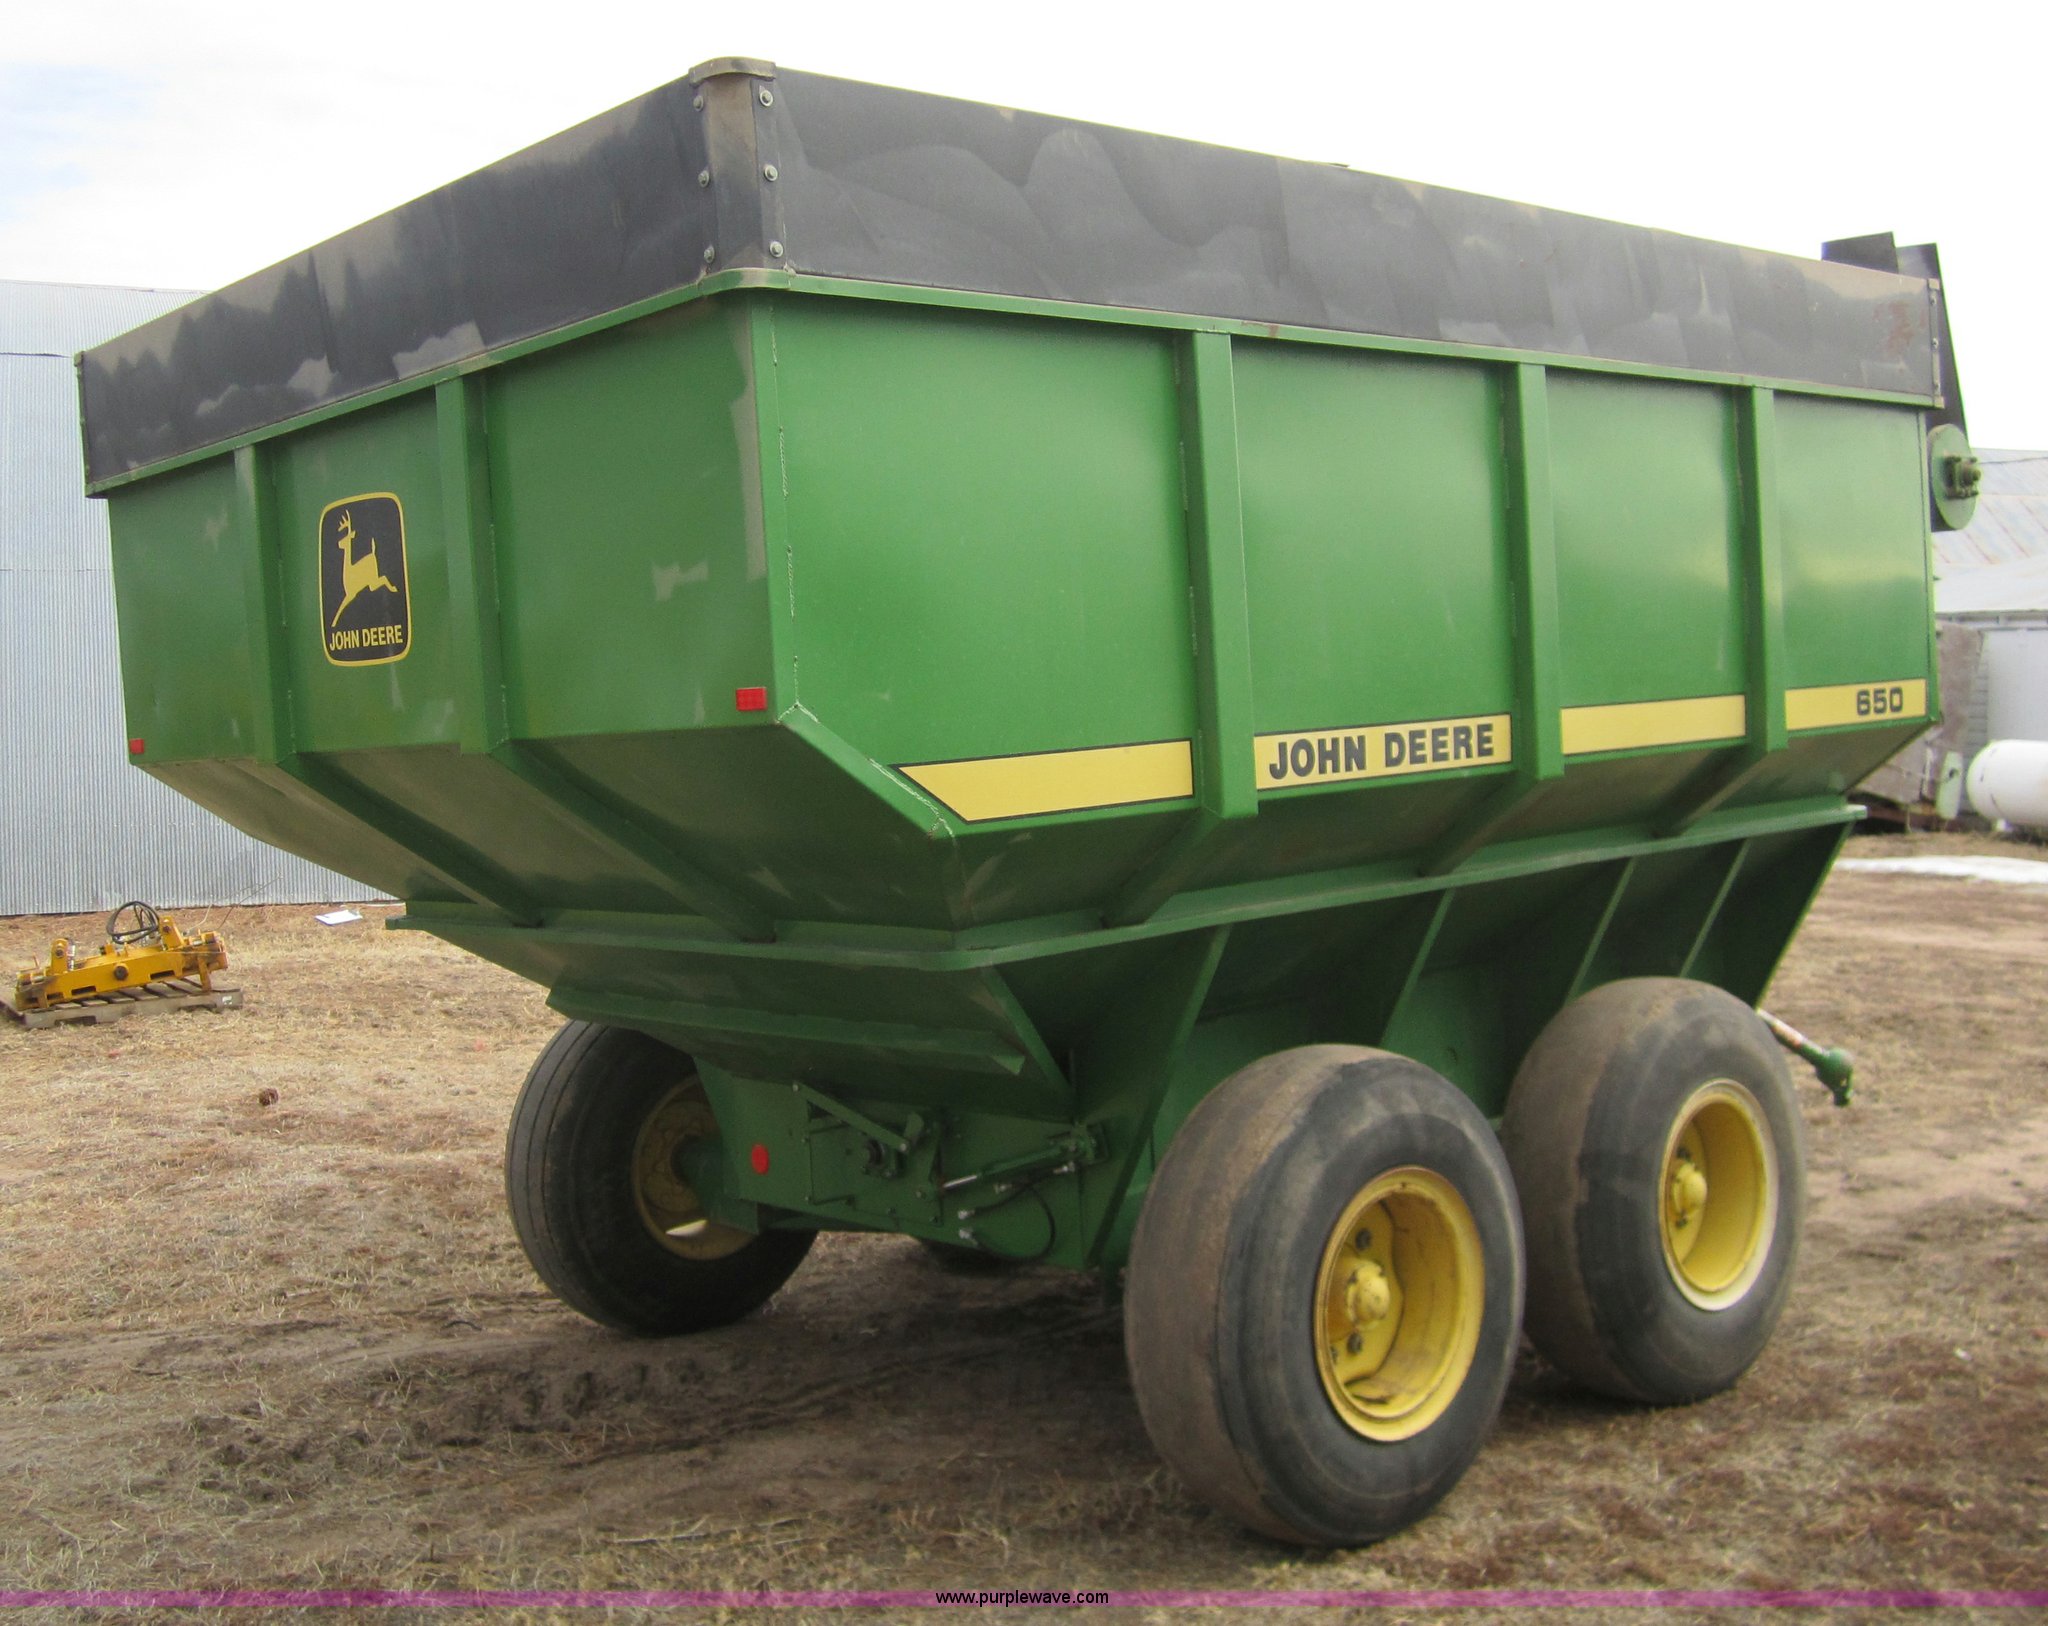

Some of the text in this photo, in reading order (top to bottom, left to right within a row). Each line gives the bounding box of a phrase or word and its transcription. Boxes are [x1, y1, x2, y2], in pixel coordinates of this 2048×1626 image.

[329, 624, 403, 651] JOHN DEERE
[1856, 686, 1904, 716] 650
[1269, 723, 1494, 780] JOHN DEERE
